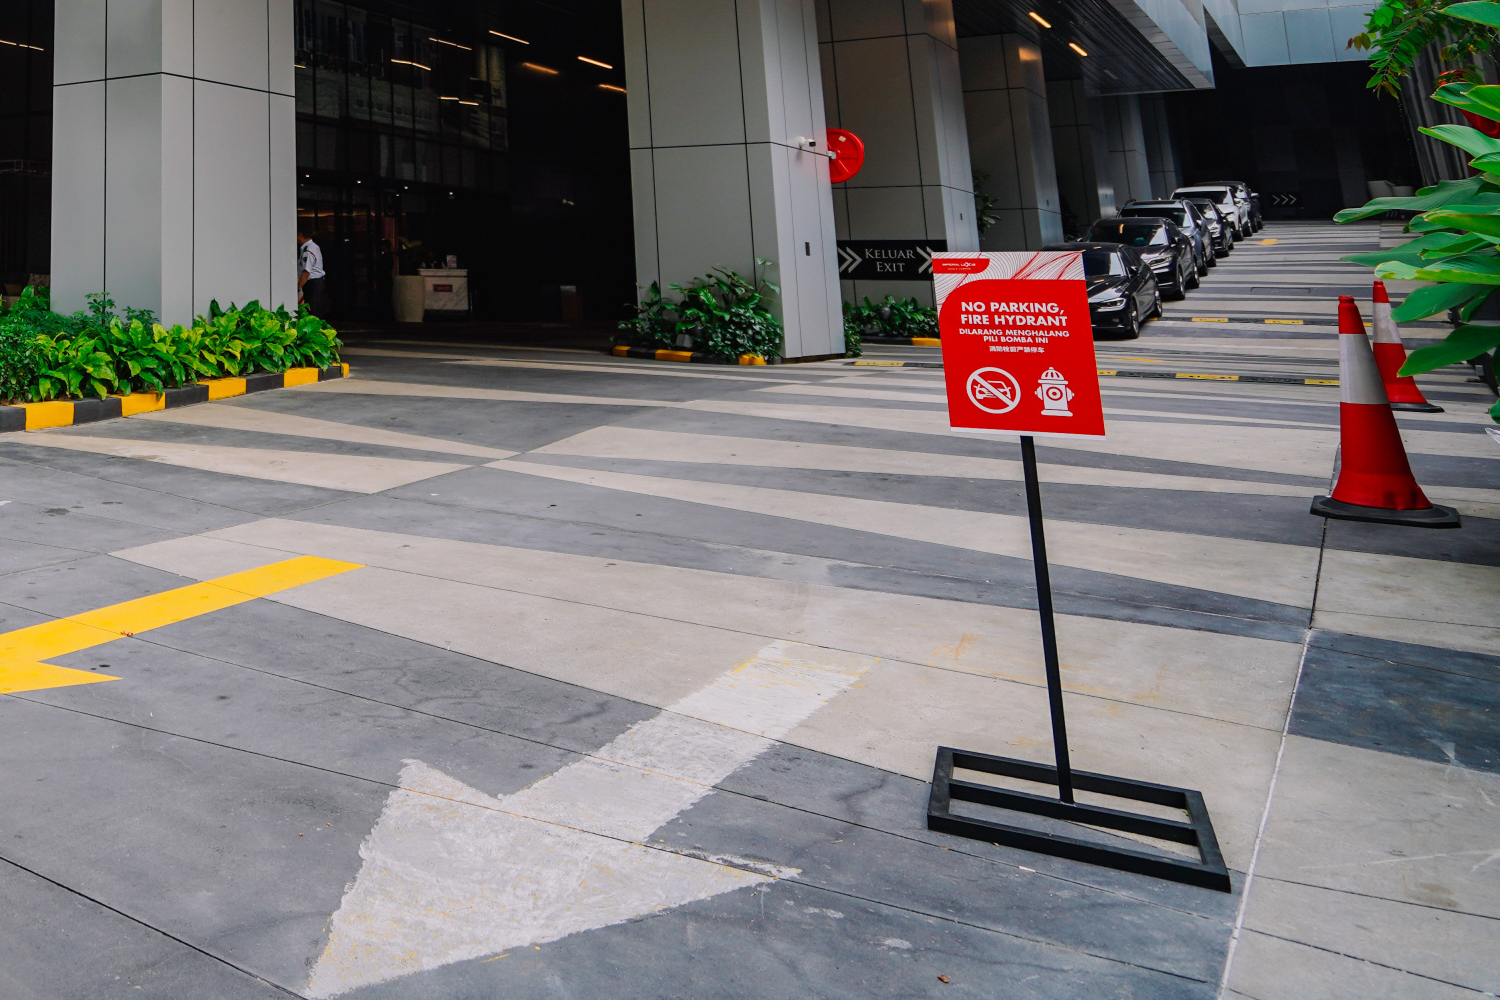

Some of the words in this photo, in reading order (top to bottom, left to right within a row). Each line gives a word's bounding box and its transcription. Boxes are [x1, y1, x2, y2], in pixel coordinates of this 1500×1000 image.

[865, 248, 916, 259] KELUAR
[876, 261, 905, 272] EXIT
[961, 301, 986, 312] NO
[990, 302, 1064, 315] PARKING,
[960, 314, 990, 325] FIRE
[994, 315, 1068, 326] HYDRANT
[1005, 329, 1070, 337] MENGHALANG
